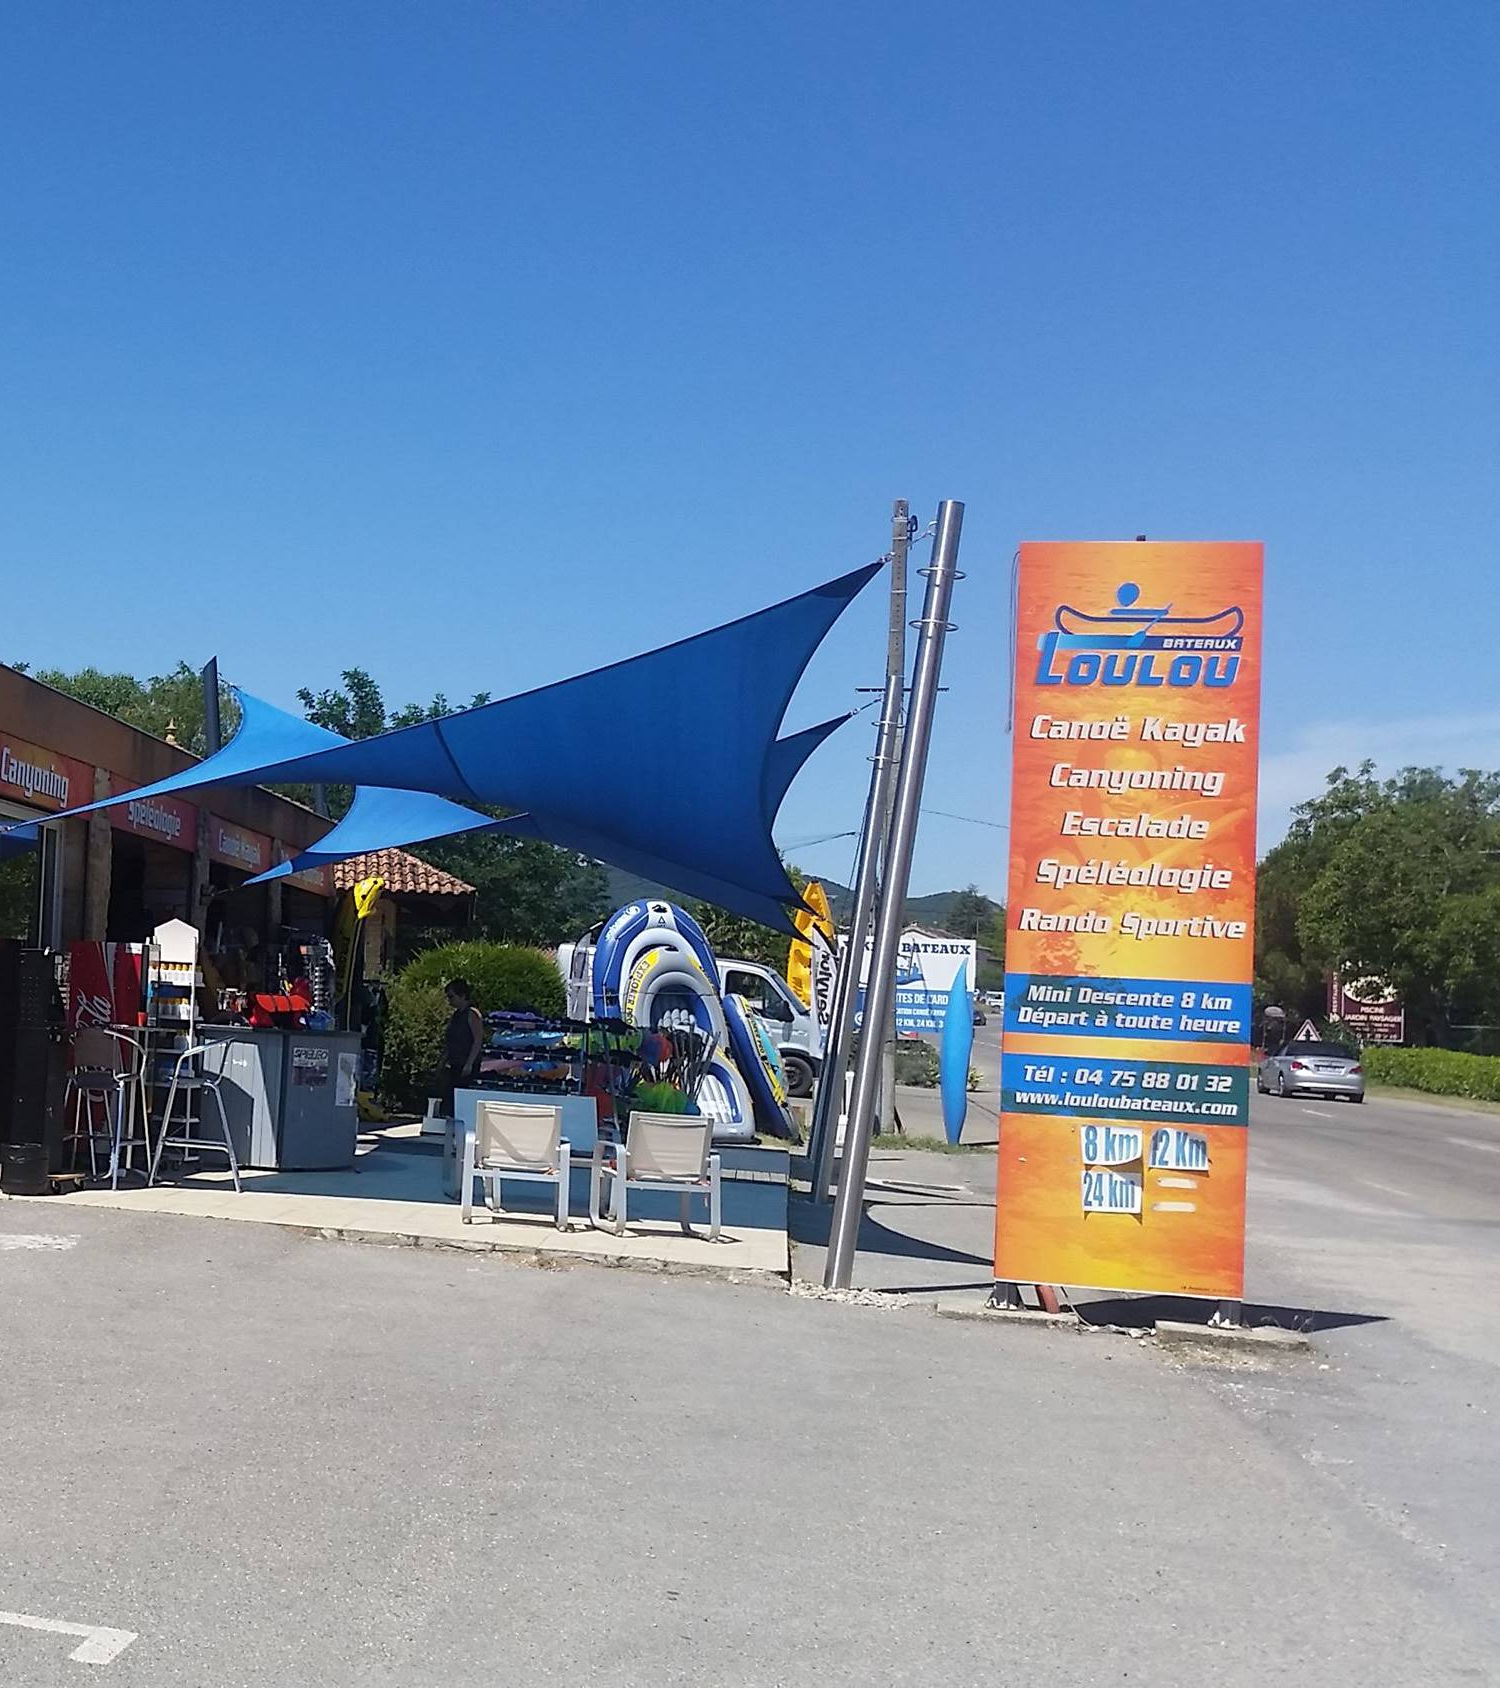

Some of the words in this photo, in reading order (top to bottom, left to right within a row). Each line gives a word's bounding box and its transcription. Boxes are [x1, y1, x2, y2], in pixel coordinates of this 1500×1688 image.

[1162, 638, 1238, 649] BATEAUX
[1034, 632, 1242, 687] LOULOU
[1030, 715, 1130, 741] Canoë
[1140, 718, 1247, 747] Kayak
[1, 747, 69, 809] Canyoning
[1050, 763, 1225, 796] Canyoning
[1061, 811, 1210, 839] Escalade
[1036, 858, 1232, 894] Spéléologie
[1018, 908, 1112, 933] Rando
[1119, 912, 1247, 941] Sportive
[902, 943, 971, 955] BATEAUX
[896, 993, 913, 1004] TES
[914, 994, 925, 1004] DE
[927, 994, 949, 1005] L'ARD
[1027, 985, 1072, 1004] Mini
[1077, 988, 1175, 1009] Descente
[1180, 992, 1195, 1009] 8
[1200, 992, 1232, 1011] km
[938, 1020, 944, 1029] 3
[1018, 1007, 1088, 1028] Départ
[1095, 1011, 1108, 1027] à
[1115, 1012, 1173, 1030] toute
[1179, 1014, 1241, 1034] heure
[1024, 1065, 1054, 1083] Tél
[1060, 1070, 1068, 1084] :
[1074, 1068, 1103, 1086] 04
[1110, 1070, 1137, 1087] 75
[1142, 1071, 1170, 1090] 88
[1176, 1074, 1199, 1091] 01
[1204, 1075, 1232, 1093] 32
[1015, 1091, 1238, 1116] www.louloubateaux.com
[1085, 1125, 1098, 1161] 8
[1104, 1127, 1139, 1161] km
[1151, 1129, 1170, 1166] 12
[1084, 1172, 1104, 1207] 24
[1108, 1173, 1135, 1208] km
